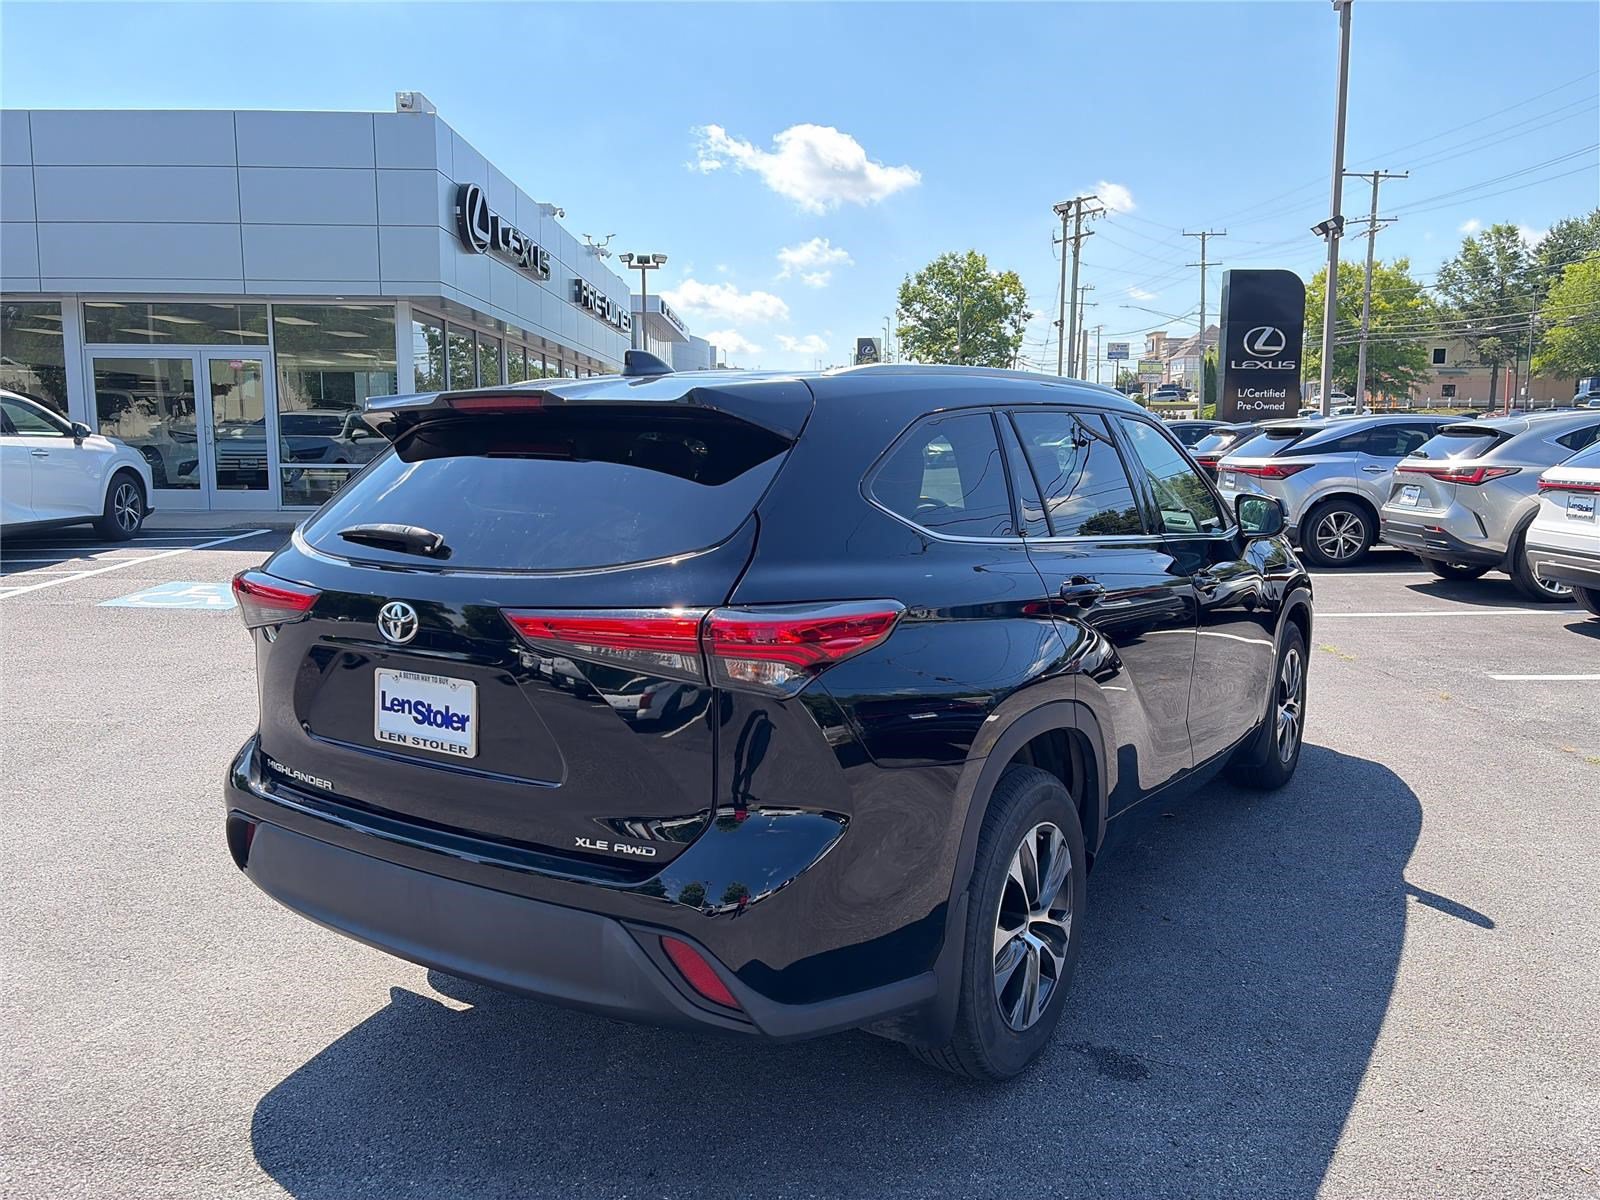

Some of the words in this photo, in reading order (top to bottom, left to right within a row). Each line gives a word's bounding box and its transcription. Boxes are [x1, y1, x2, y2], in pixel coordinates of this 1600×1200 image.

[490, 215, 551, 281] LEXUS
[1231, 360, 1296, 370] LEXUS
[1237, 388, 1286, 398] L/Certified
[1237, 401, 1285, 410] Pre-Owned
[403, 672, 420, 680] BETTER
[380, 731, 407, 743] LEN
[411, 736, 468, 755] STOLER
[267, 758, 332, 790] HIGHLANDER
[575, 837, 609, 850] XLE
[614, 843, 656, 857] AWD
